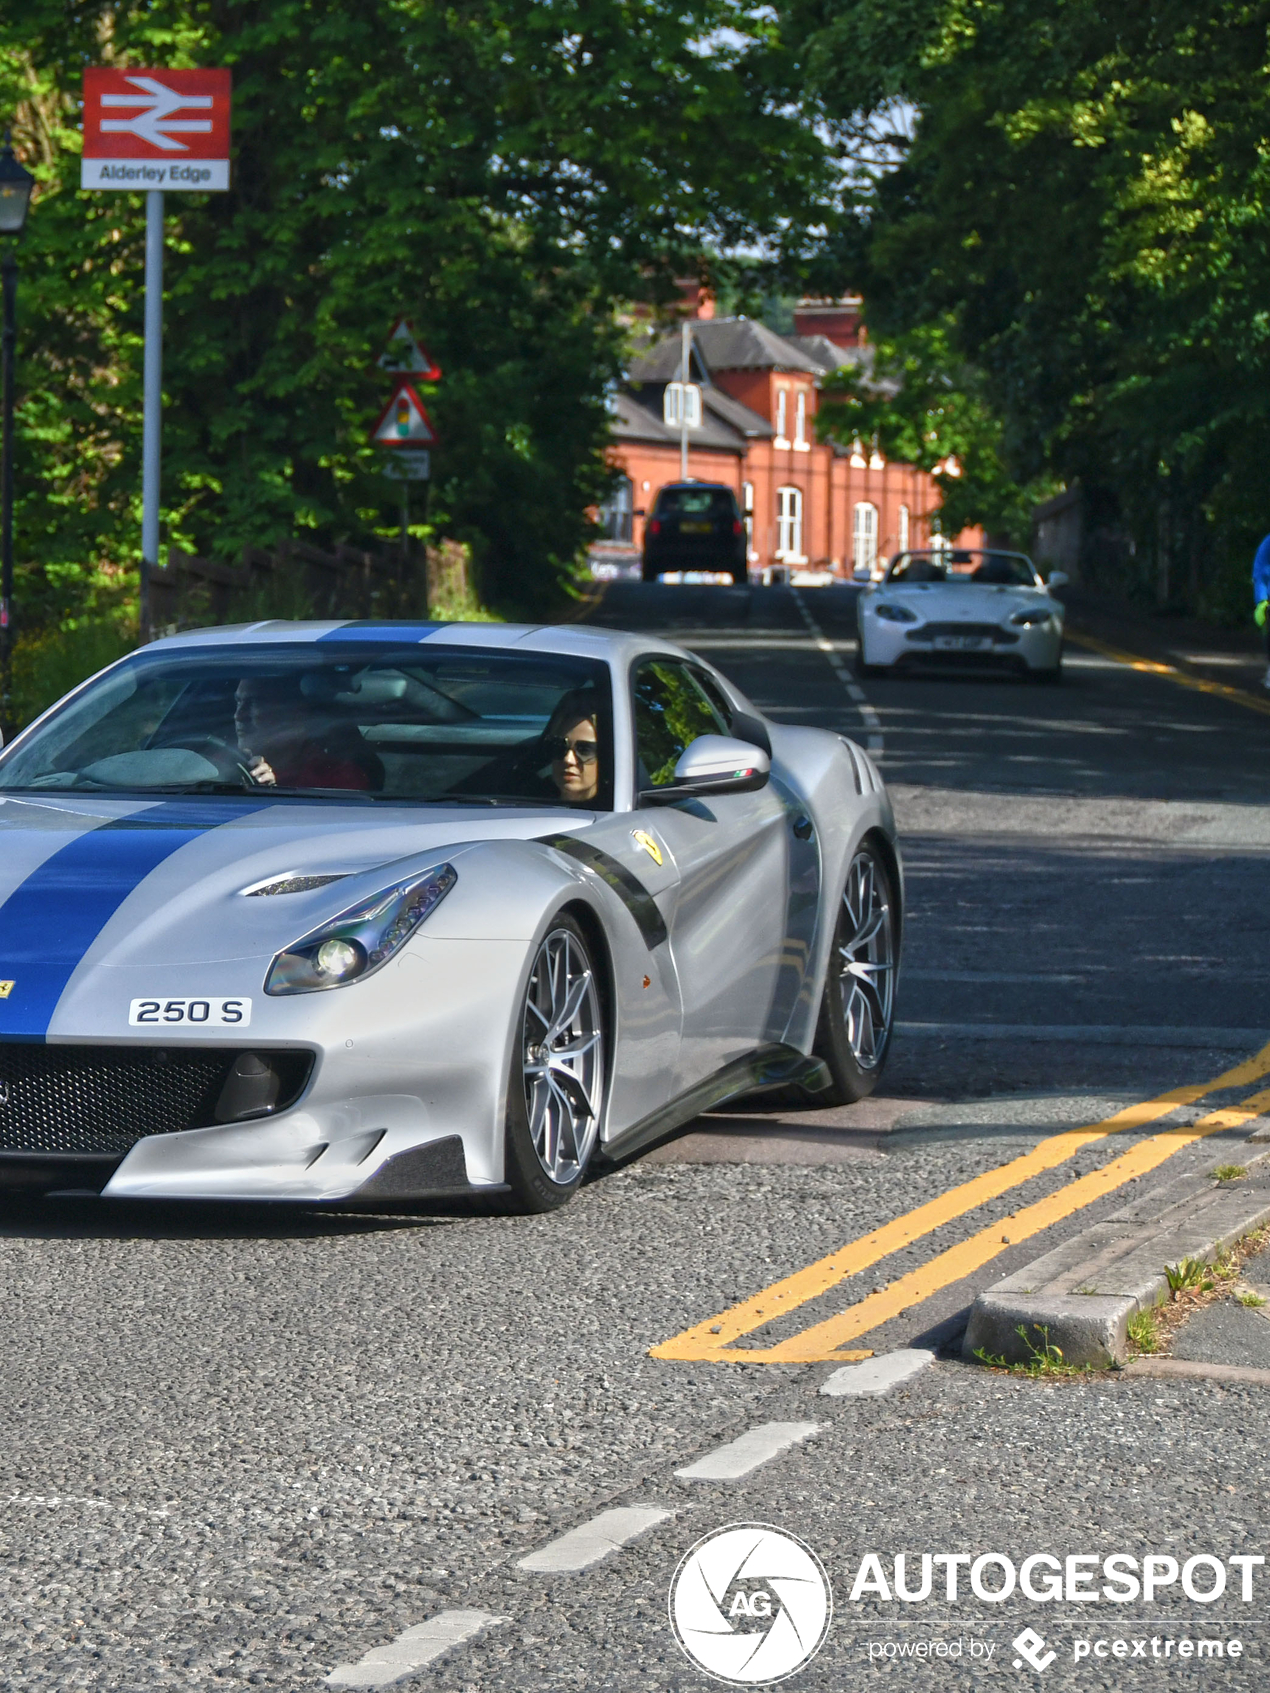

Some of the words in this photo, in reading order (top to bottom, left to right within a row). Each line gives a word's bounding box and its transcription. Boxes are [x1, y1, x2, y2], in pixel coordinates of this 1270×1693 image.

[99, 164, 166, 183] Alderley
[170, 164, 211, 183] Edge
[137, 1001, 210, 1022] 250
[221, 1000, 243, 1023] S
